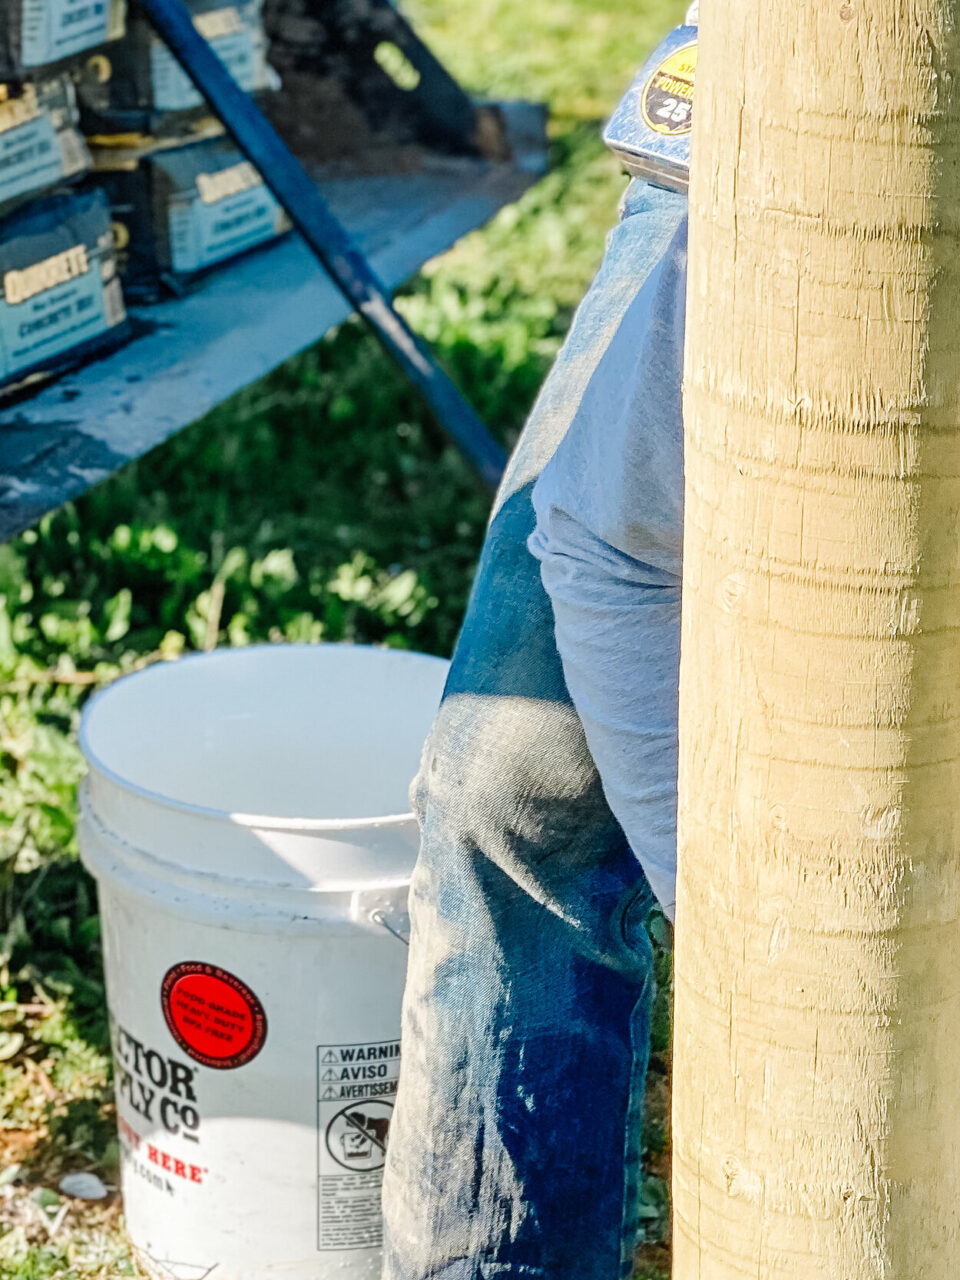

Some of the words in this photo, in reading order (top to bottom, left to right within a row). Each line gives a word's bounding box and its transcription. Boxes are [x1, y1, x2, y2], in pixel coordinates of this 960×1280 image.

[177, 1001, 209, 1019] HEAVY
[214, 1017, 244, 1032] DUTY
[209, 1002, 245, 1020] GRADE
[206, 1027, 233, 1042] FREE
[341, 1064, 387, 1080] AVISO
[147, 1141, 203, 1184] HERE
